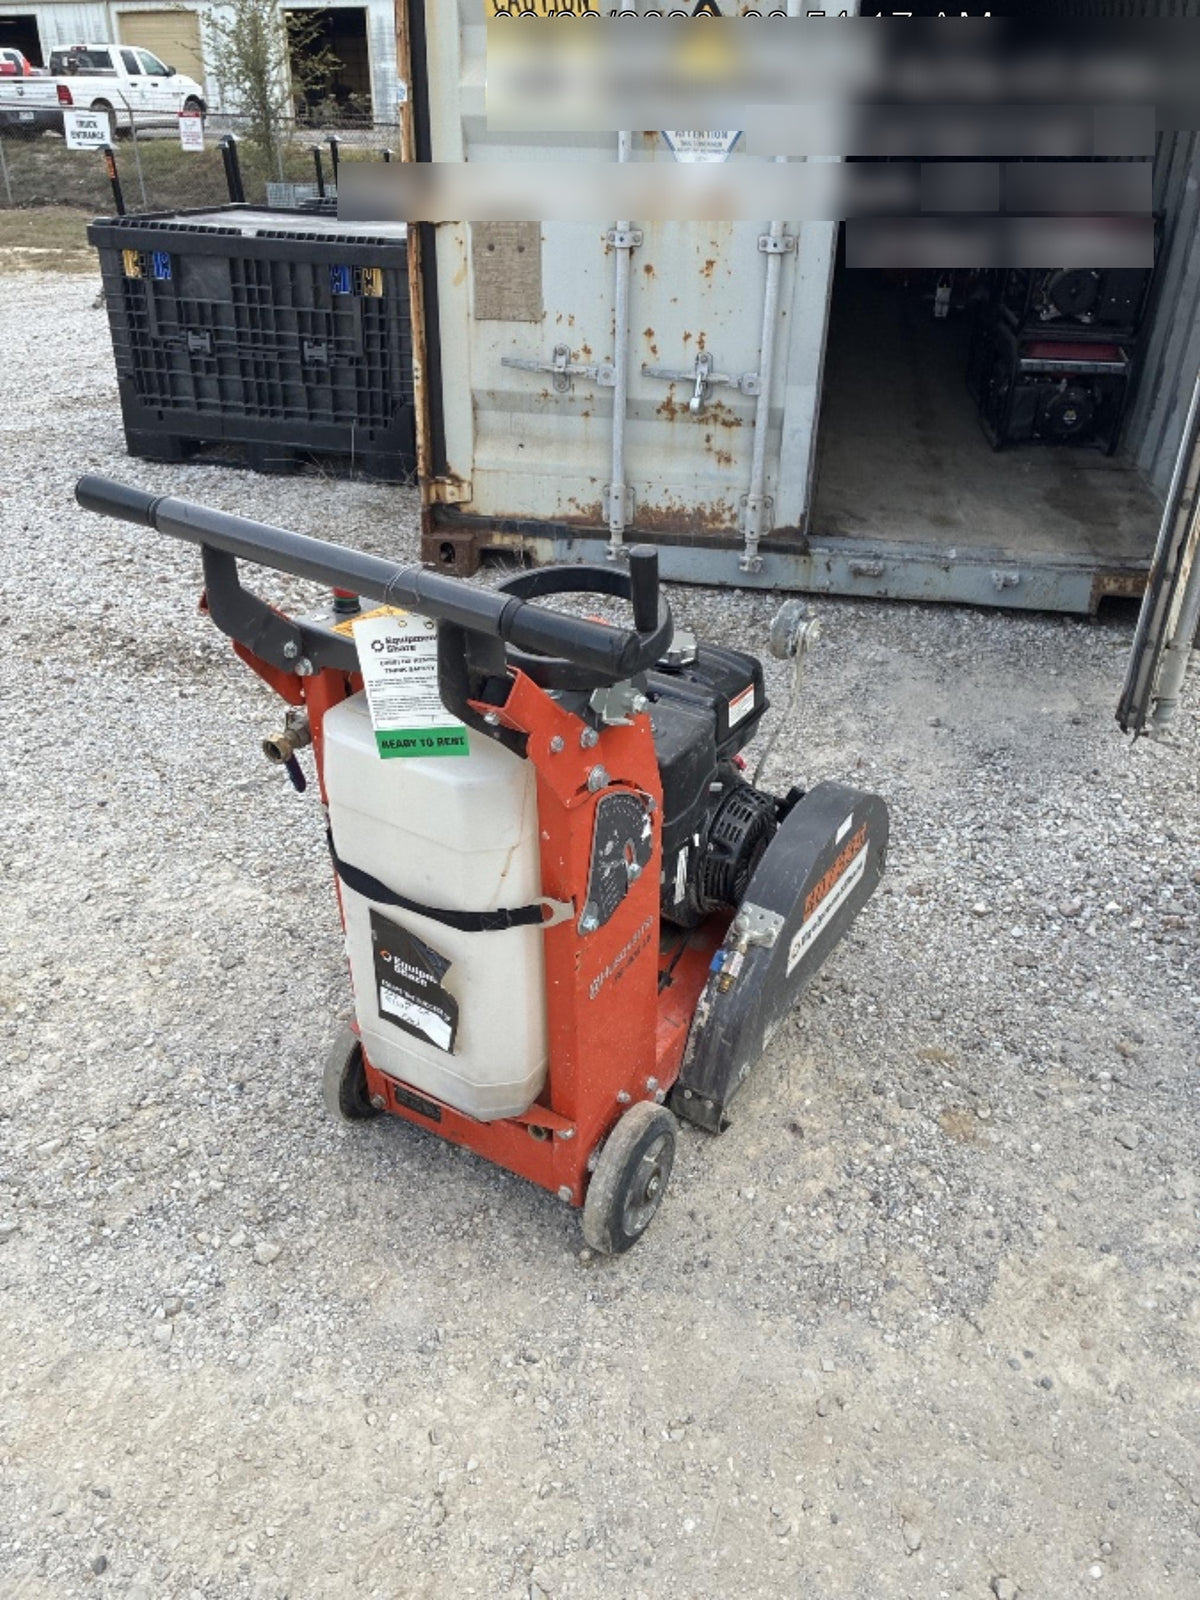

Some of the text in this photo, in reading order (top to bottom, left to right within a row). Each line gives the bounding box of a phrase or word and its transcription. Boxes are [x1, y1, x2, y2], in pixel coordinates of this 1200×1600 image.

[76, 120, 98, 128] TRUCK
[71, 131, 105, 140] ENTRANCE
[382, 736, 464, 749] READY TO RENT
